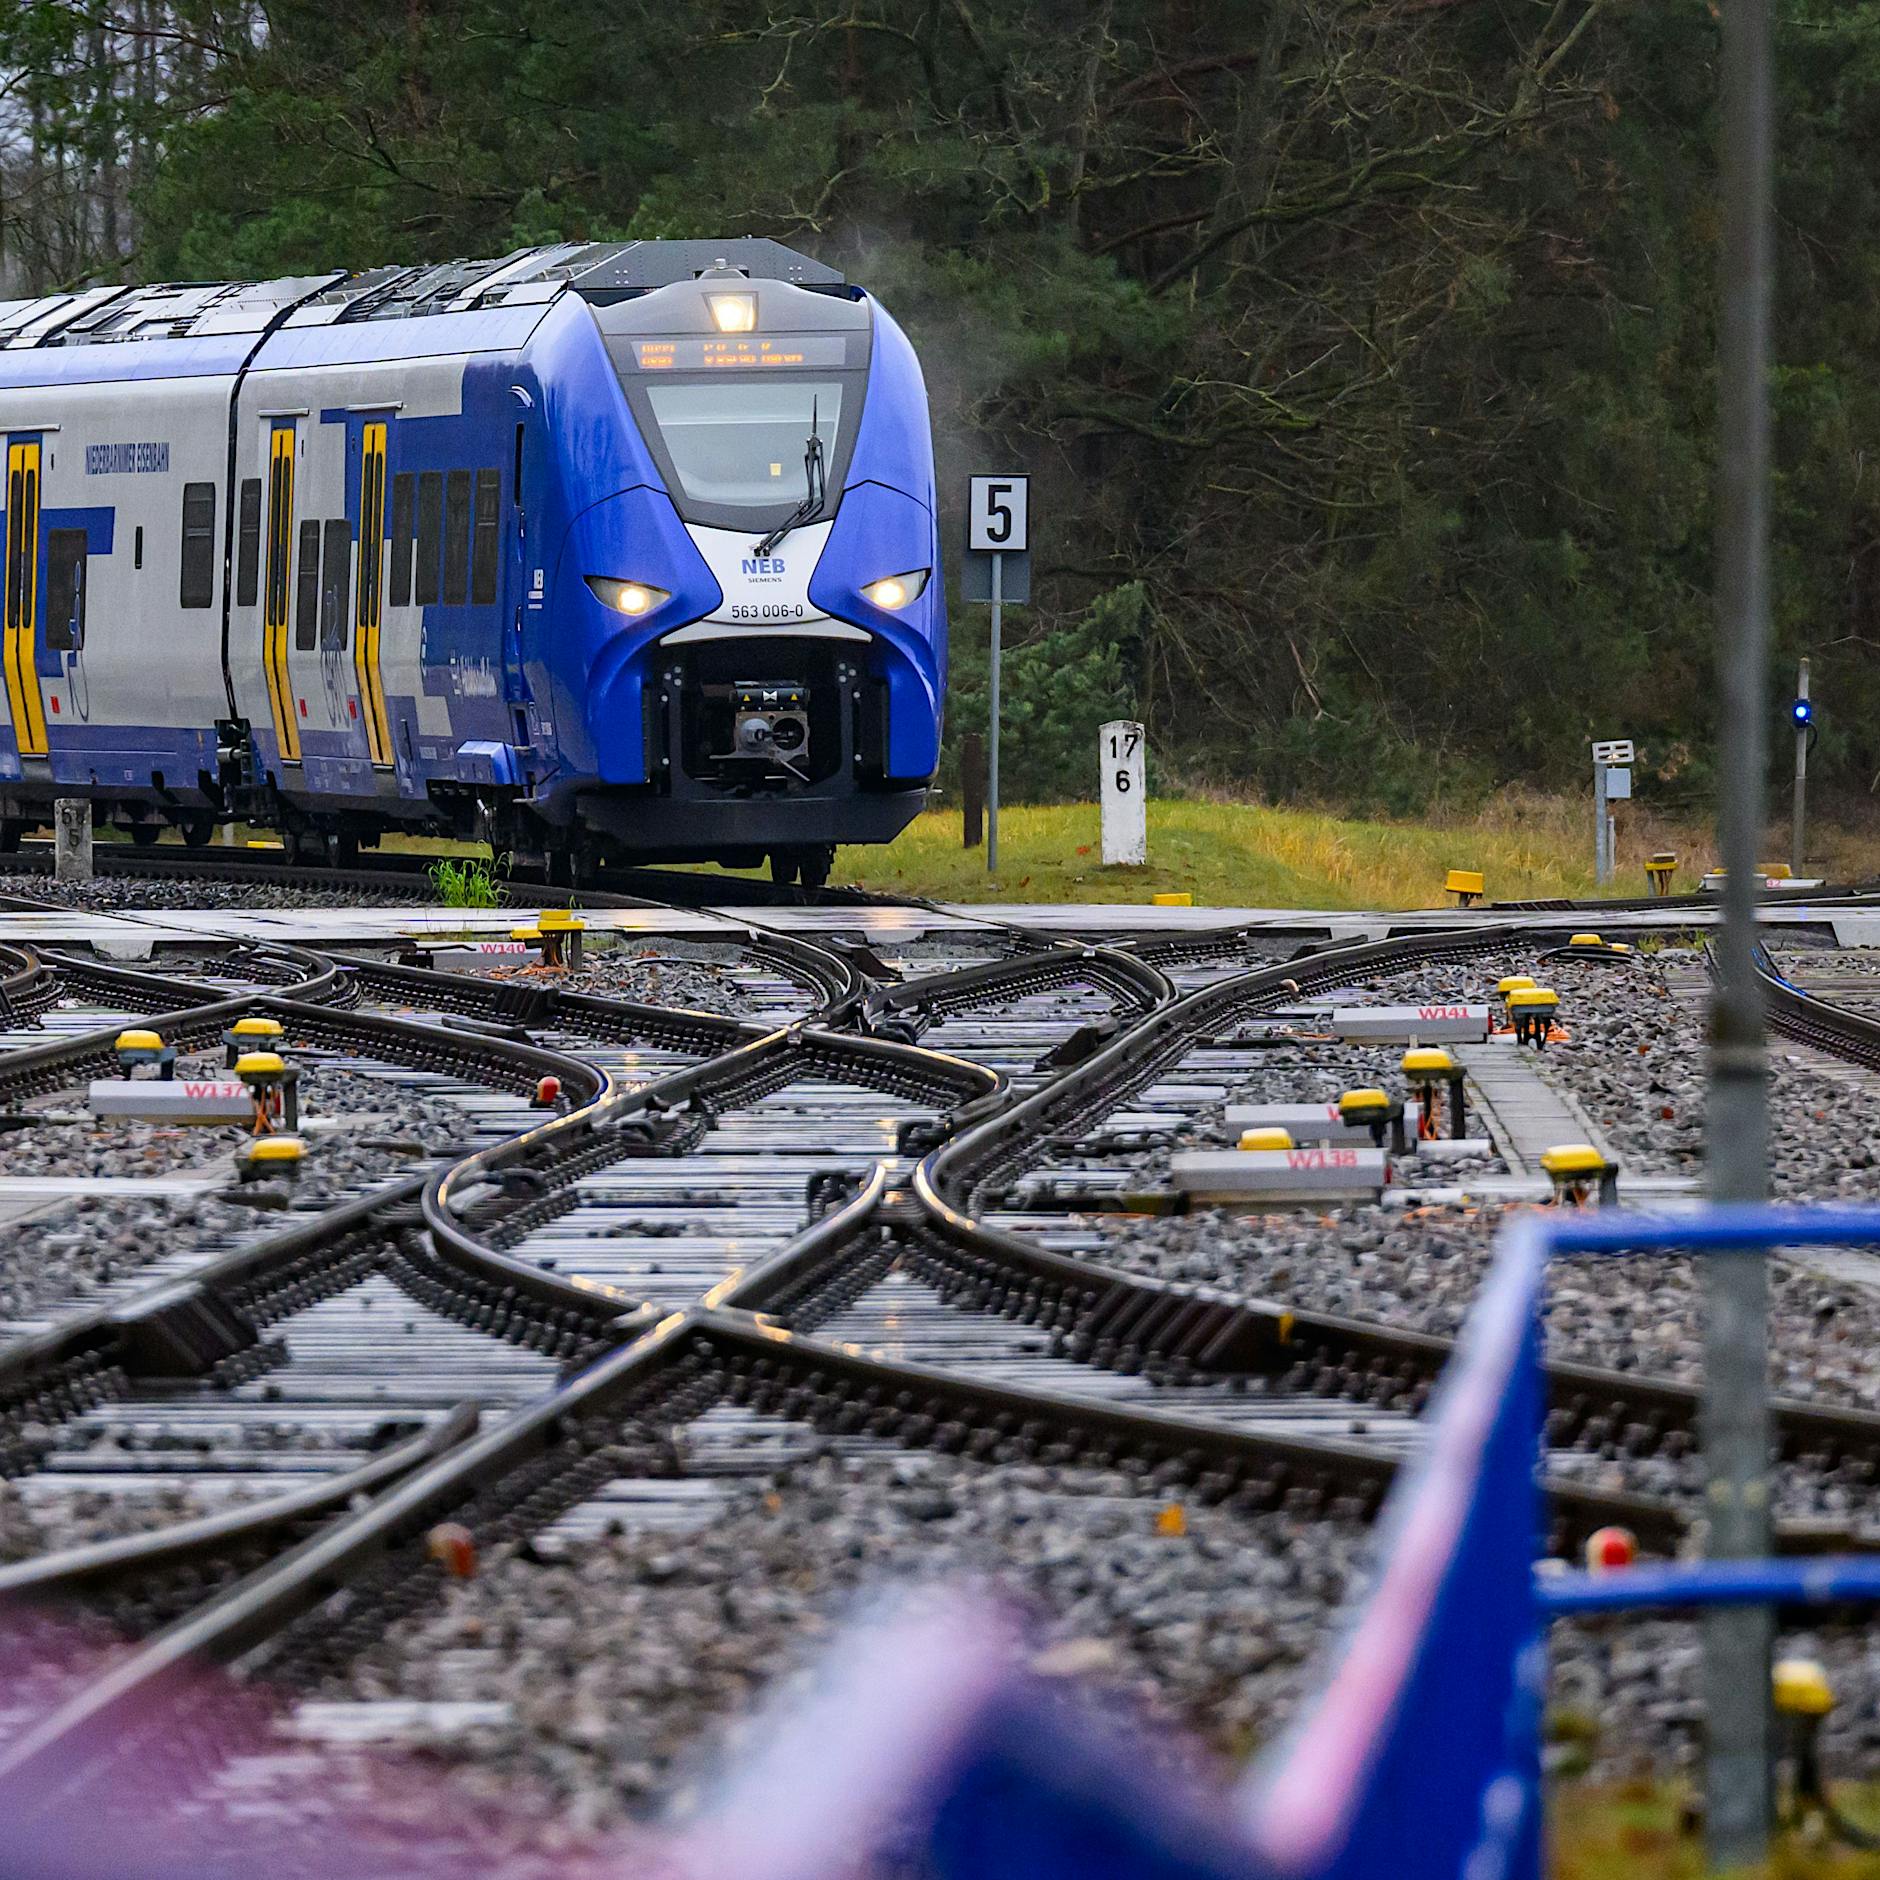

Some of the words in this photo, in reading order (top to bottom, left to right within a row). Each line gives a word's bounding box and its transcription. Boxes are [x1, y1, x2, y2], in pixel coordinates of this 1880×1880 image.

[986, 484, 1011, 543] 5
[741, 559, 785, 574] NEB
[731, 605, 758, 618] 563
[762, 604, 803, 617] 006-0
[1110, 734, 1138, 758] 17
[1115, 770, 1130, 792] 6
[481, 943, 526, 954] W140
[1418, 1007, 1469, 1020] W141
[184, 1083, 245, 1099] W137
[1286, 1150, 1357, 1169] W138
